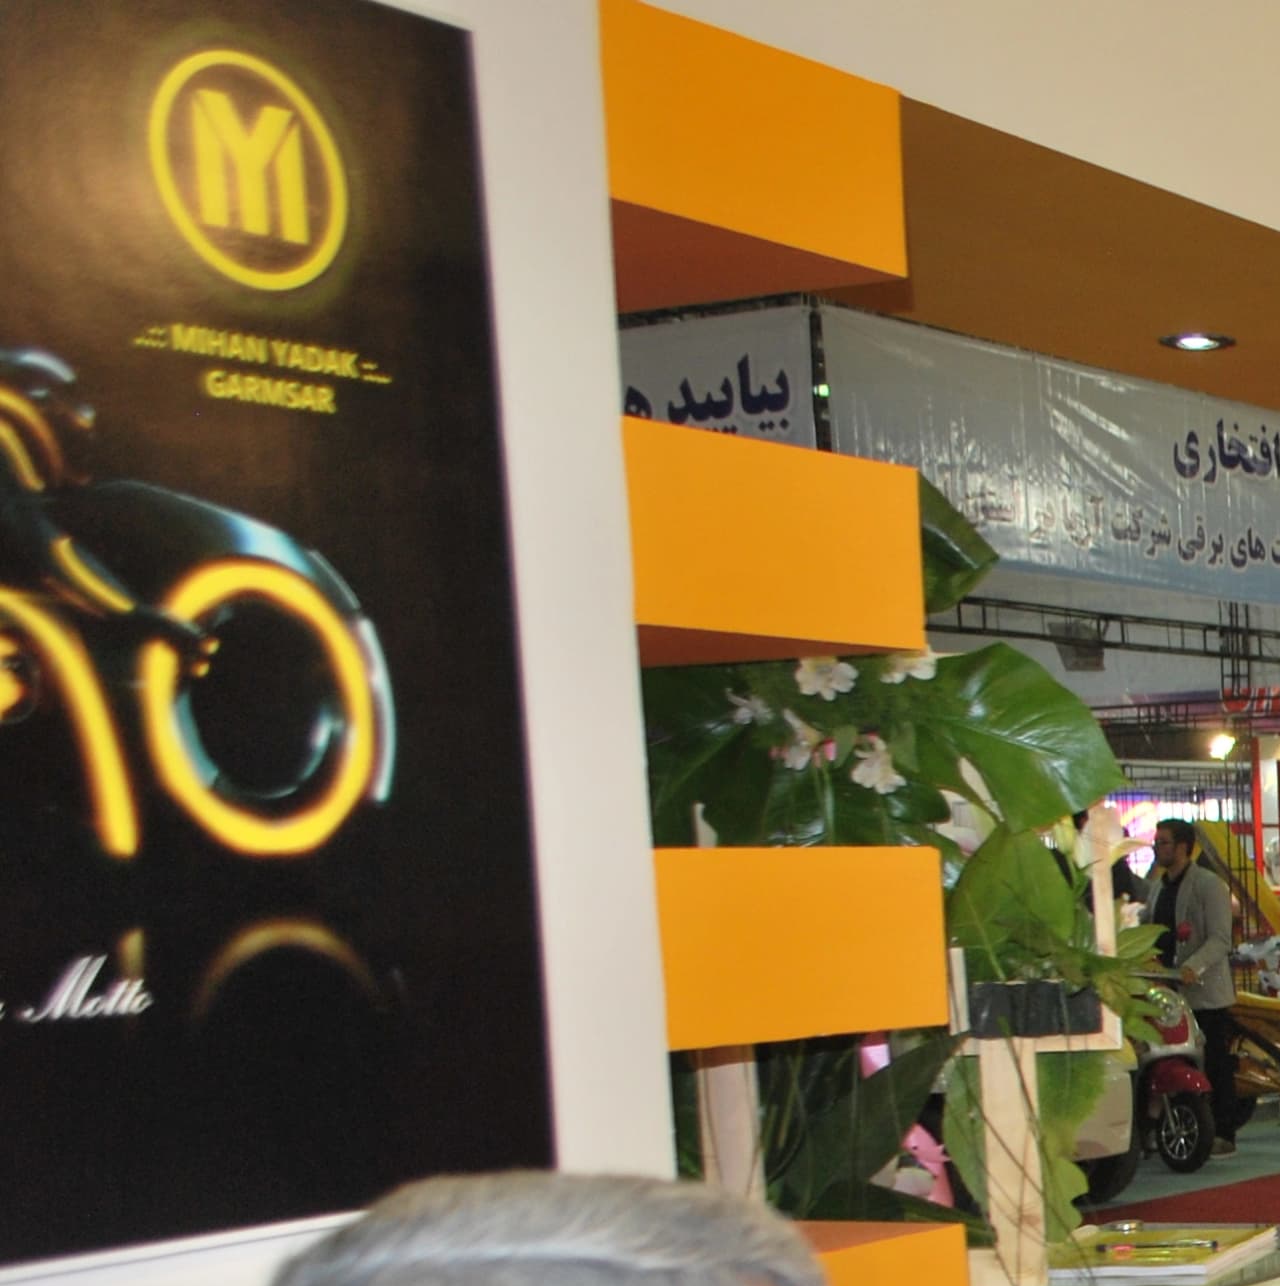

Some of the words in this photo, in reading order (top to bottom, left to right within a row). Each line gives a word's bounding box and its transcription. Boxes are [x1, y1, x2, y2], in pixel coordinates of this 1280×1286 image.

[171, 322, 268, 365] MIHAN
[271, 340, 360, 380] YADAK
[204, 369, 338, 415] GARMSAR
[1230, 527, 1266, 568] های
